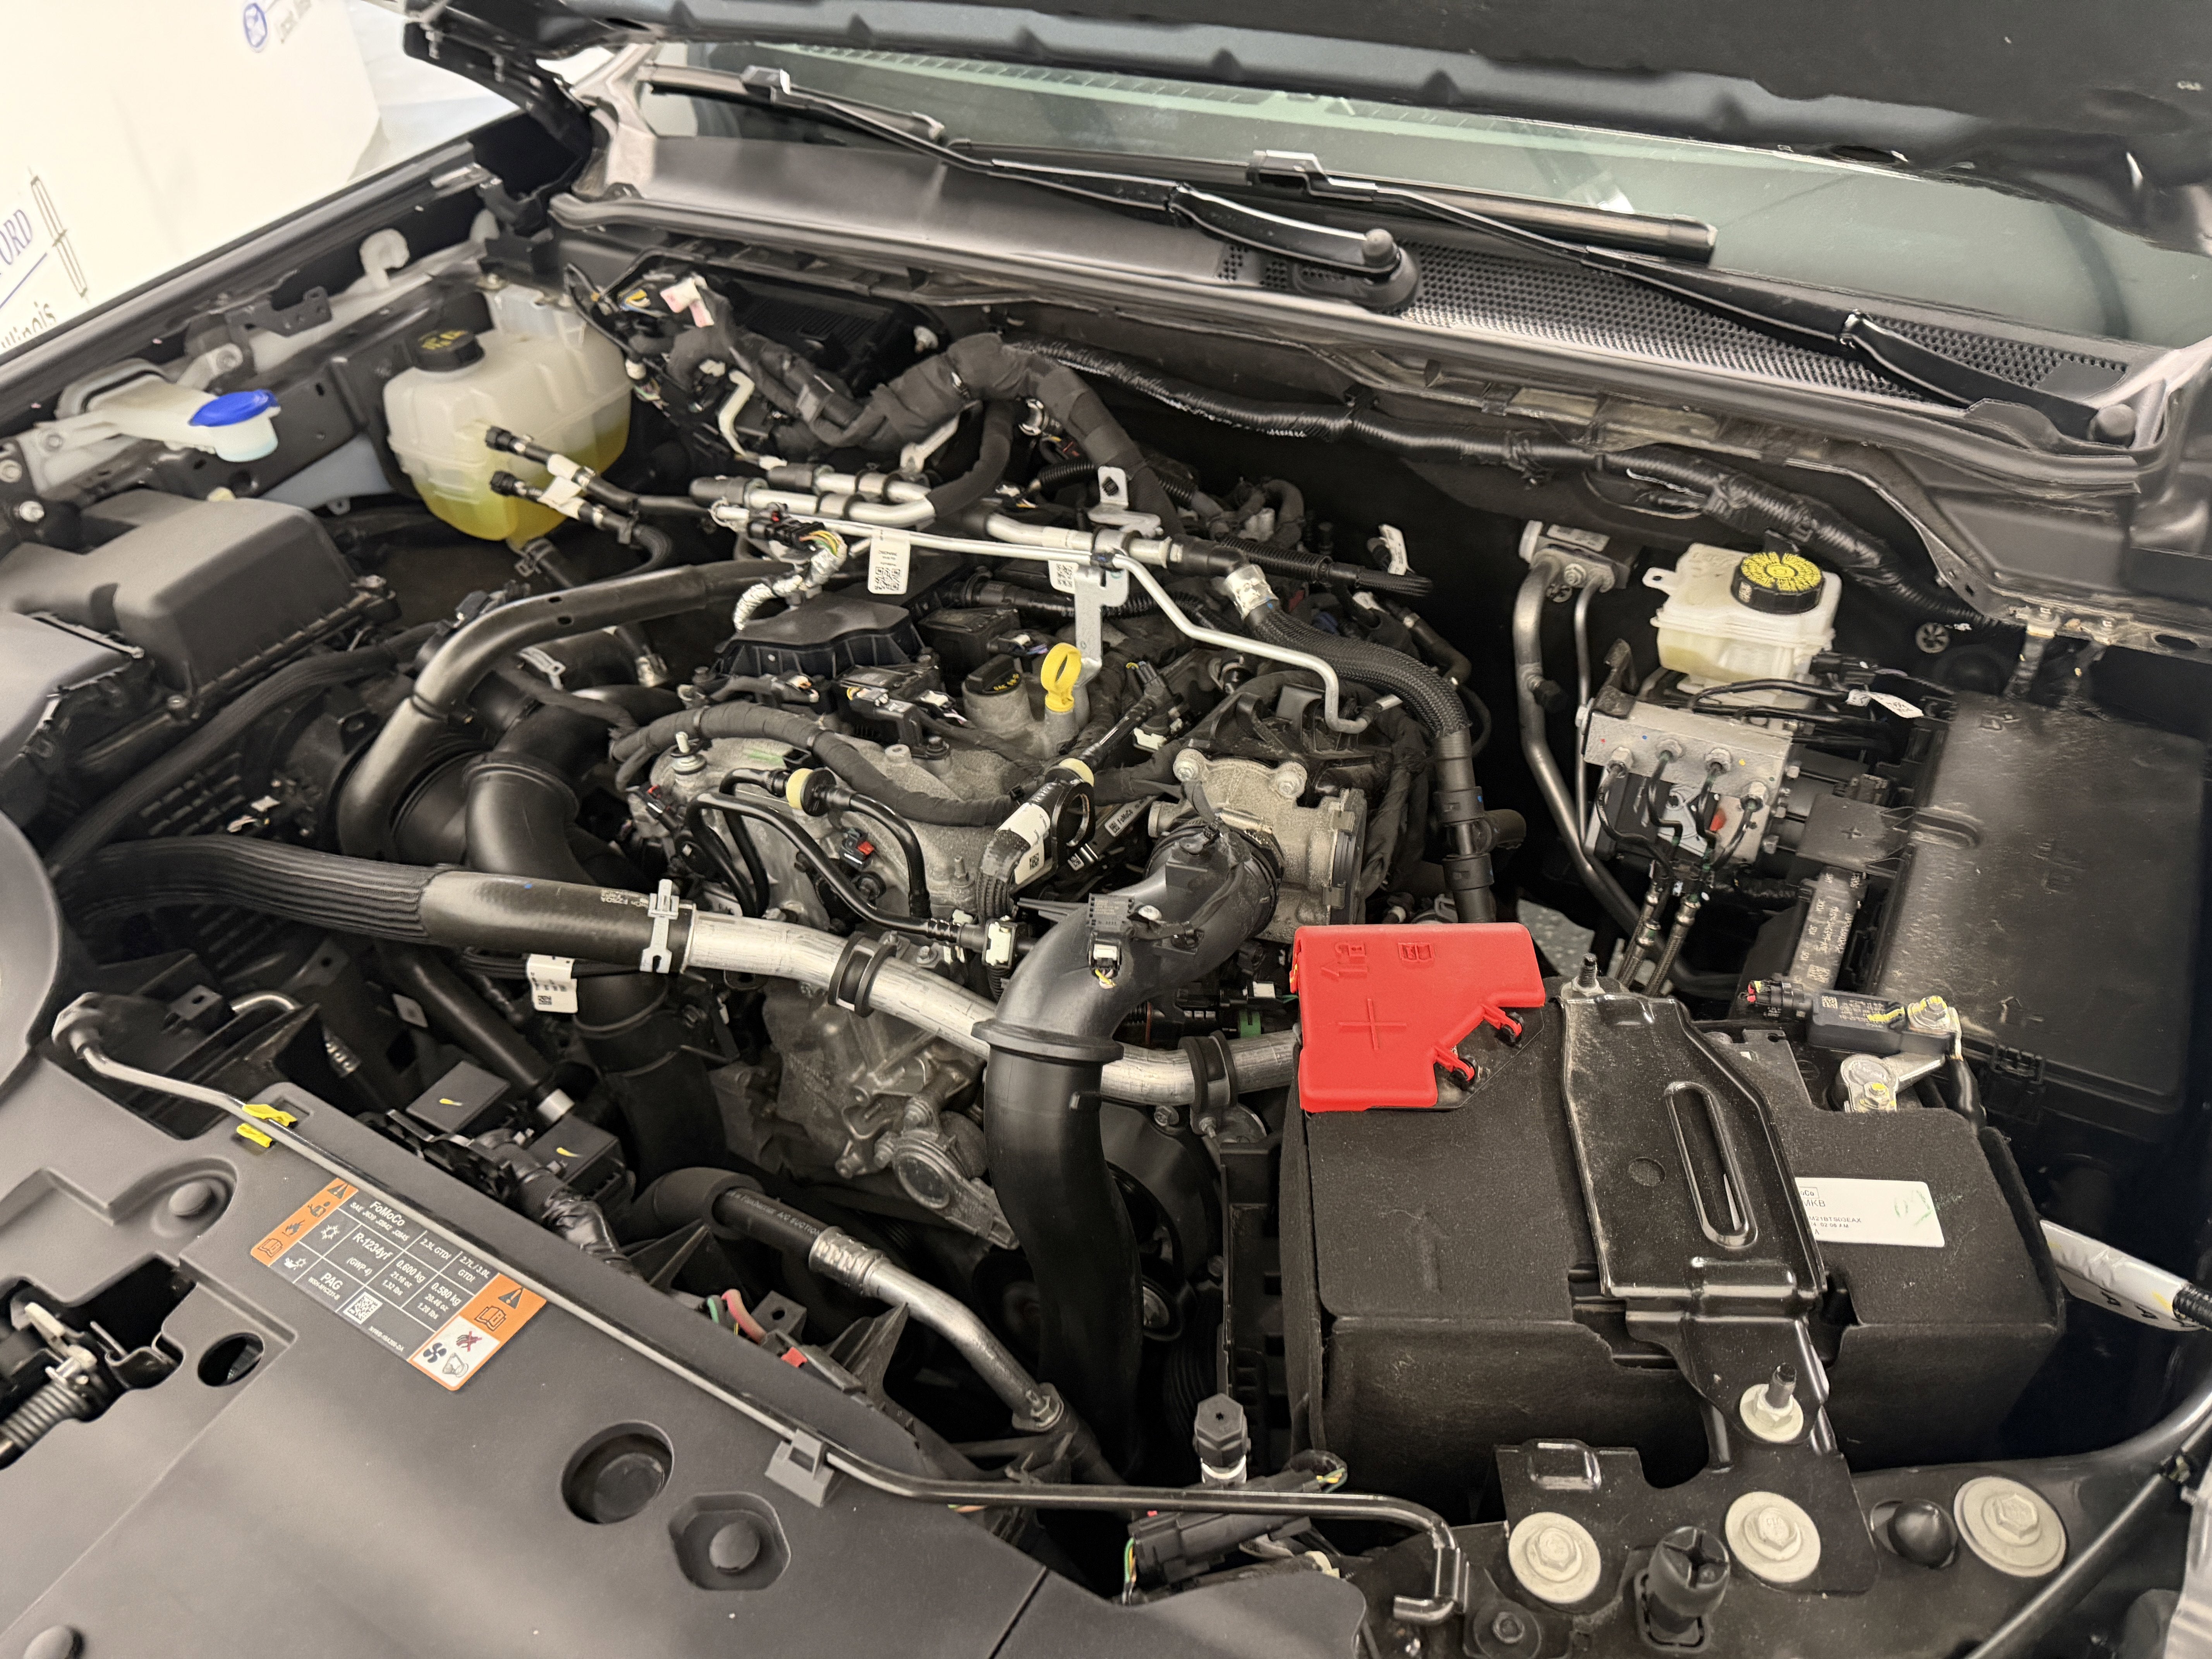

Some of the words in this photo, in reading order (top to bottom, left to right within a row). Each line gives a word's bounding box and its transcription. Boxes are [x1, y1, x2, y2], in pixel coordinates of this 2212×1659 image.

[0, 209, 33, 266] ORD
[350, 1202, 364, 1212] SAE
[369, 1201, 405, 1226] FoMoCo
[352, 1232, 393, 1259] R-1234yf
[420, 1239, 434, 1250] 2.3L
[434, 1247, 451, 1260] GTDI
[346, 1257, 366, 1270] (GWP
[396, 1260, 417, 1275] 0.600
[414, 1271, 426, 1283] kg
[459, 1256, 473, 1268] 2.7L
[476, 1266, 489, 1278] 3.0L
[320, 1272, 343, 1290] PAG
[458, 1269, 475, 1282] GTDI
[382, 1279, 395, 1290] 1.32
[393, 1286, 403, 1295] lbs
[431, 1282, 452, 1298] 0.580
[450, 1294, 461, 1306] kg
[428, 1310, 438, 1319] lbs
